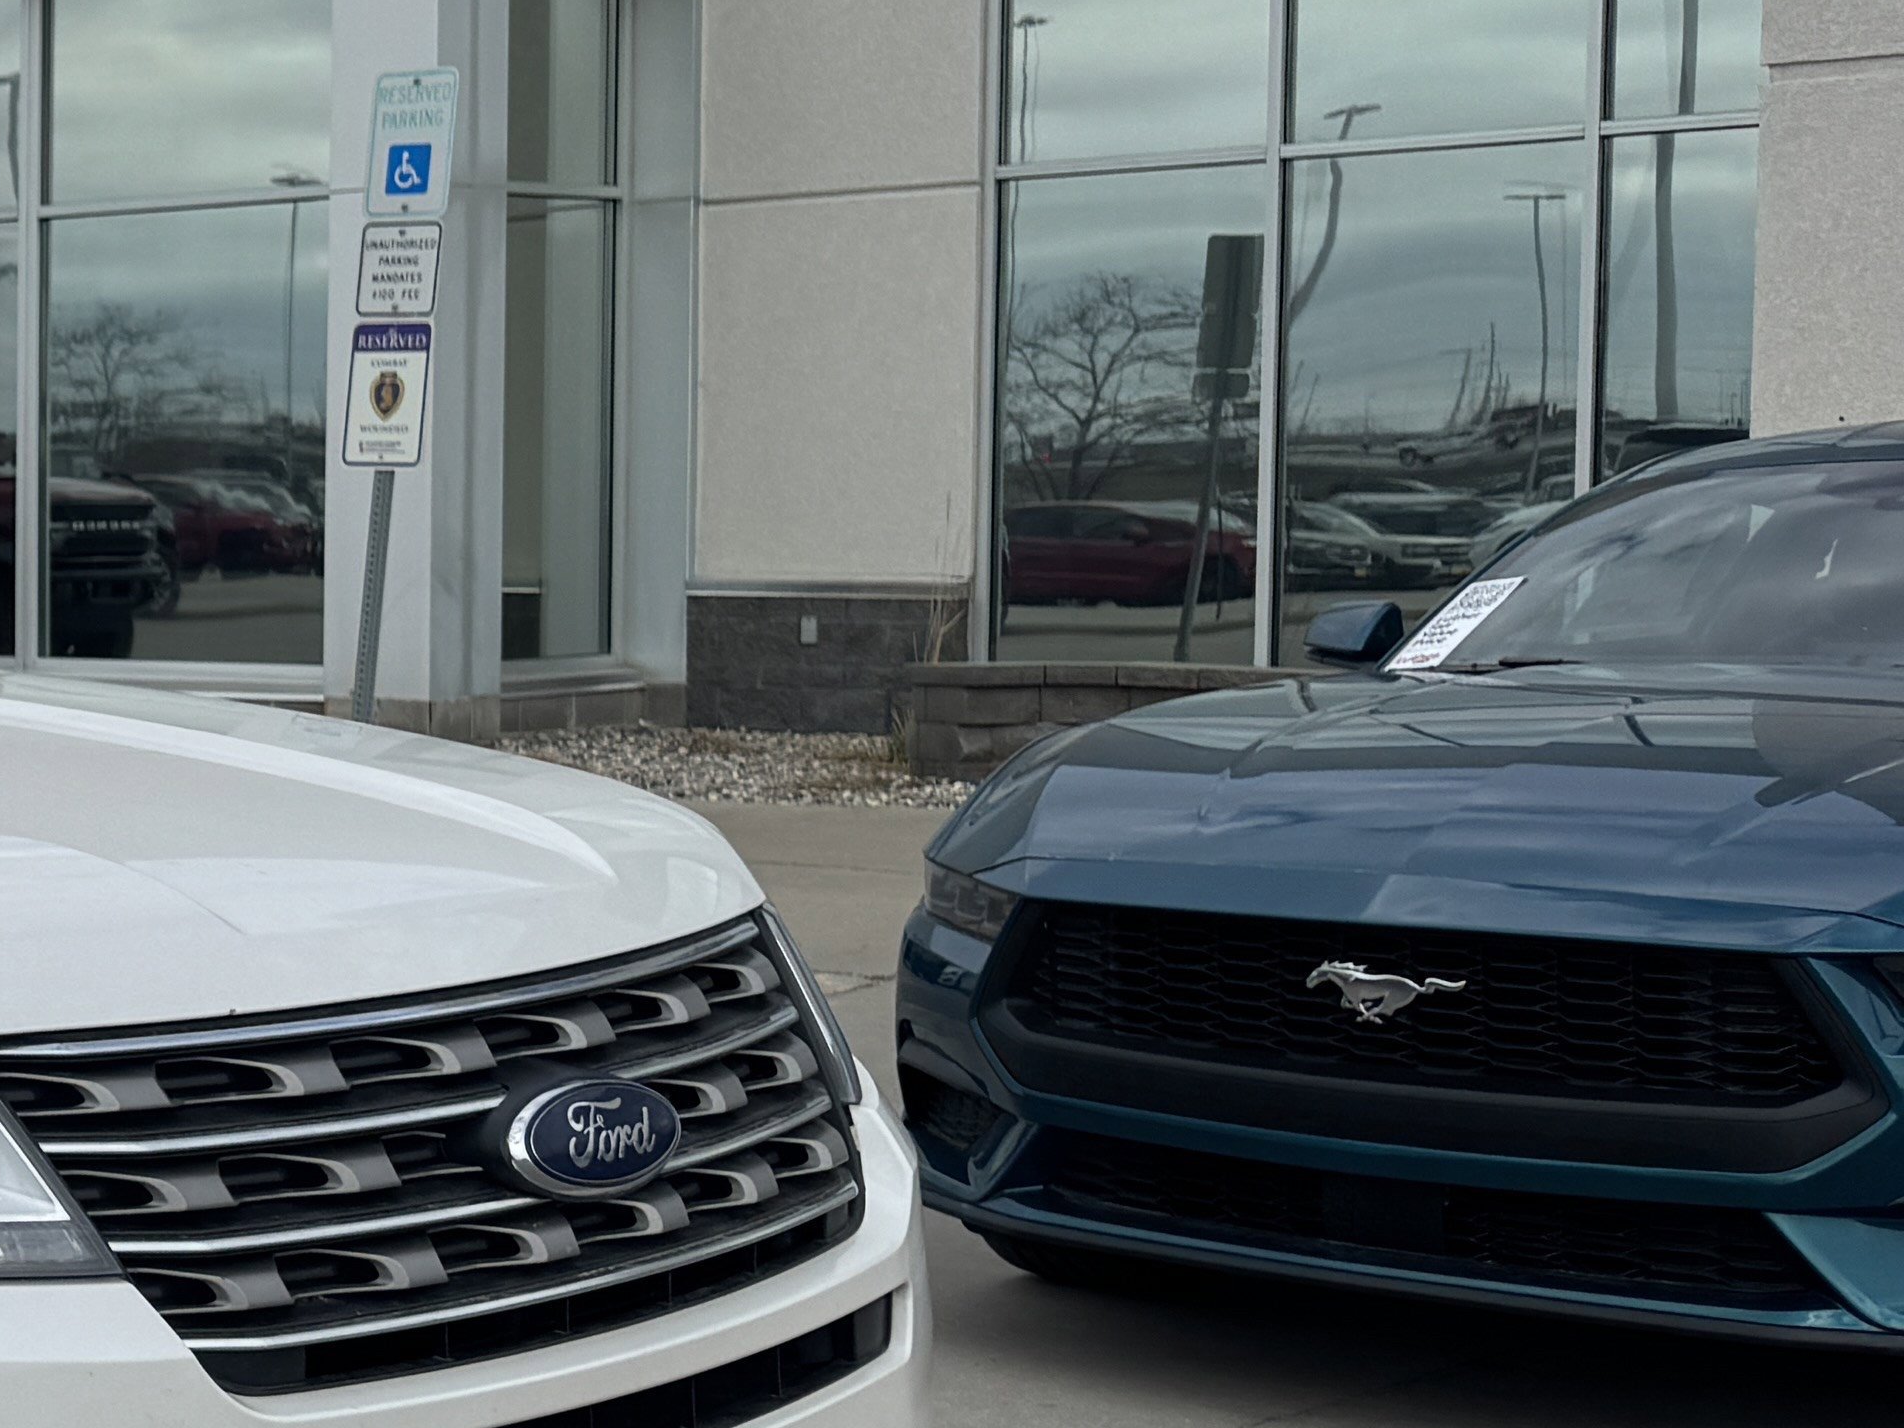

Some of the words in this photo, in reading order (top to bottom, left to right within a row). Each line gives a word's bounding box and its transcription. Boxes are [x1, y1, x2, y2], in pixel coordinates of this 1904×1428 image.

[377, 82, 452, 104] RESERVED
[382, 108, 444, 131] PARKING
[364, 238, 437, 251] UNAUTHORIZED
[378, 255, 420, 267] PARKING
[357, 332, 427, 349] RESERVED
[566, 1096, 656, 1169] Ford
